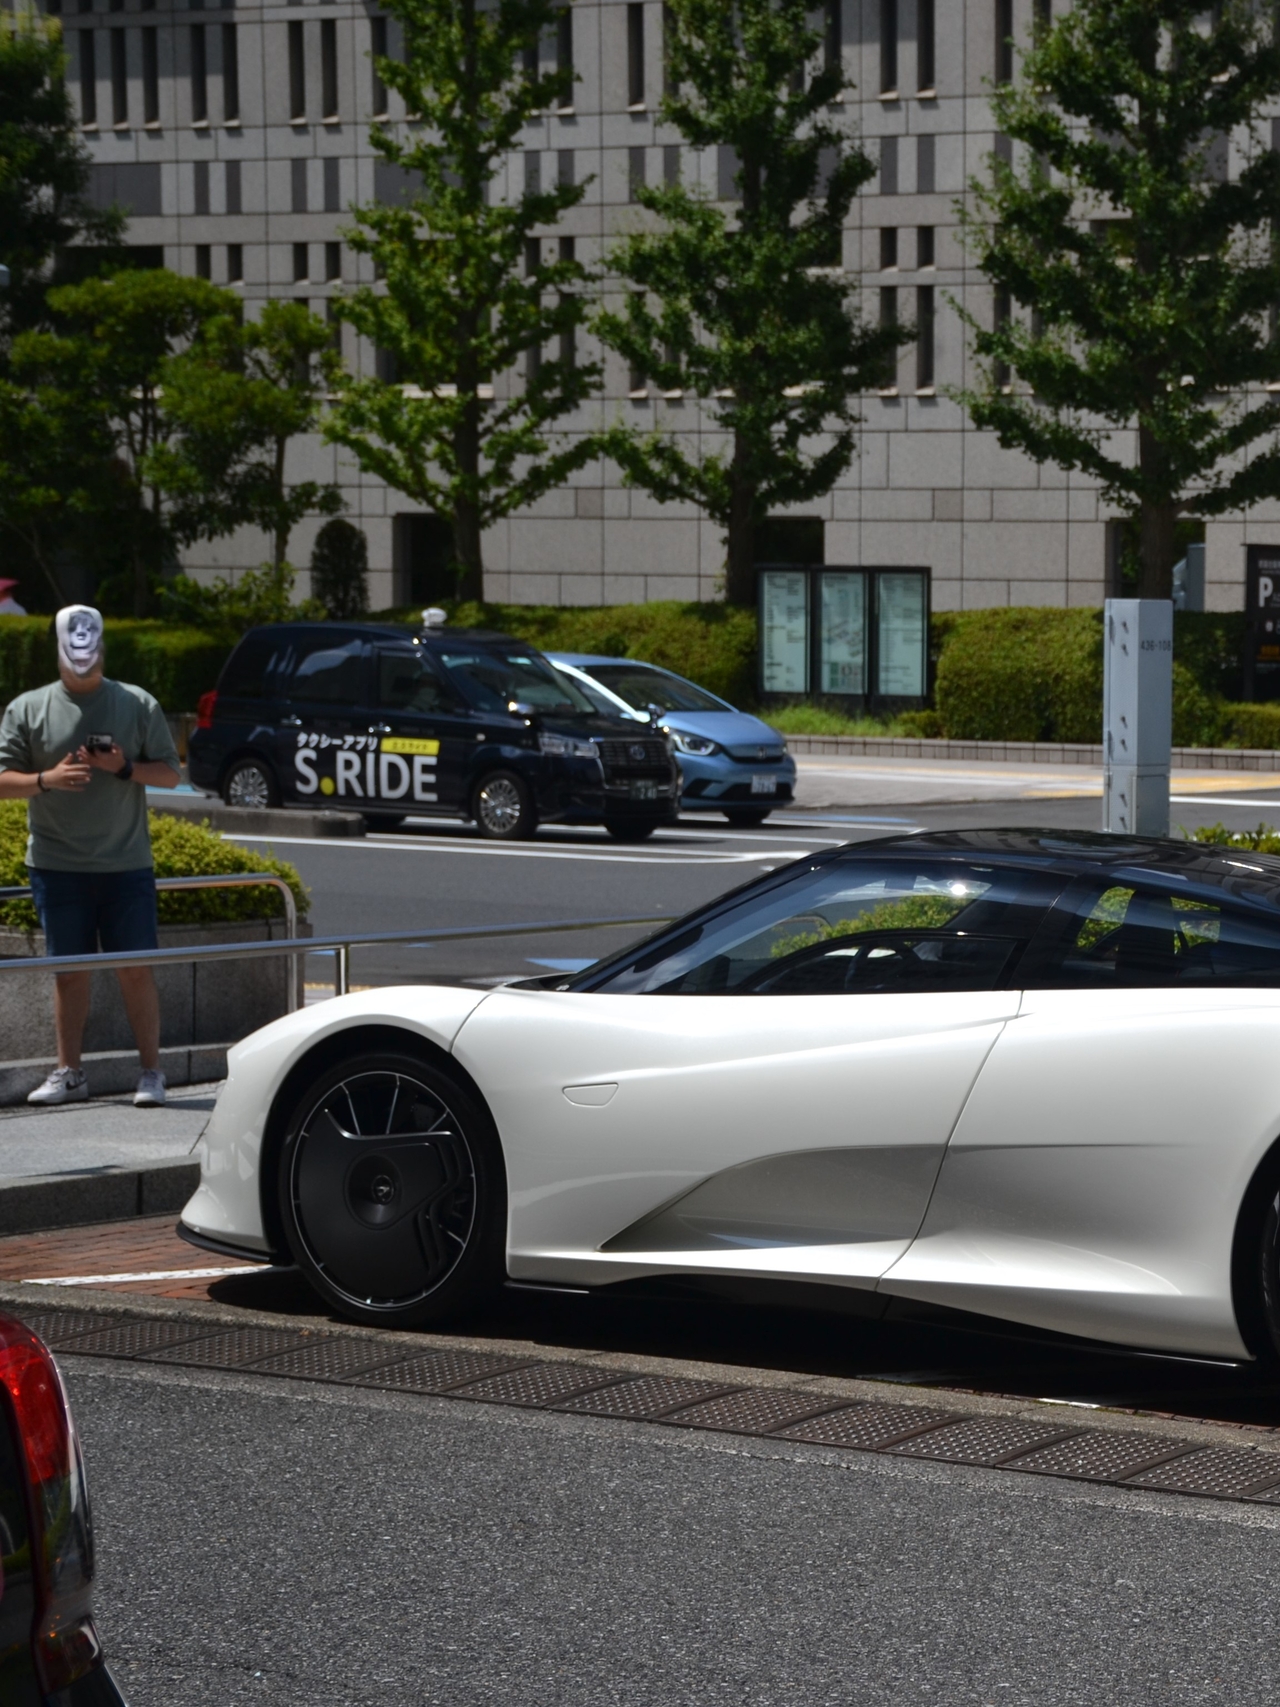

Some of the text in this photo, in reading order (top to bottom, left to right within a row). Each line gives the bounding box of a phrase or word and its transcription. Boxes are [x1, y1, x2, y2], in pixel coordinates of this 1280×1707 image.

[1258, 577, 1273, 607] P
[1140, 640, 1172, 651] 436-108
[297, 732, 378, 750] タクシーアプリ
[294, 748, 438, 802] S.RIDE
